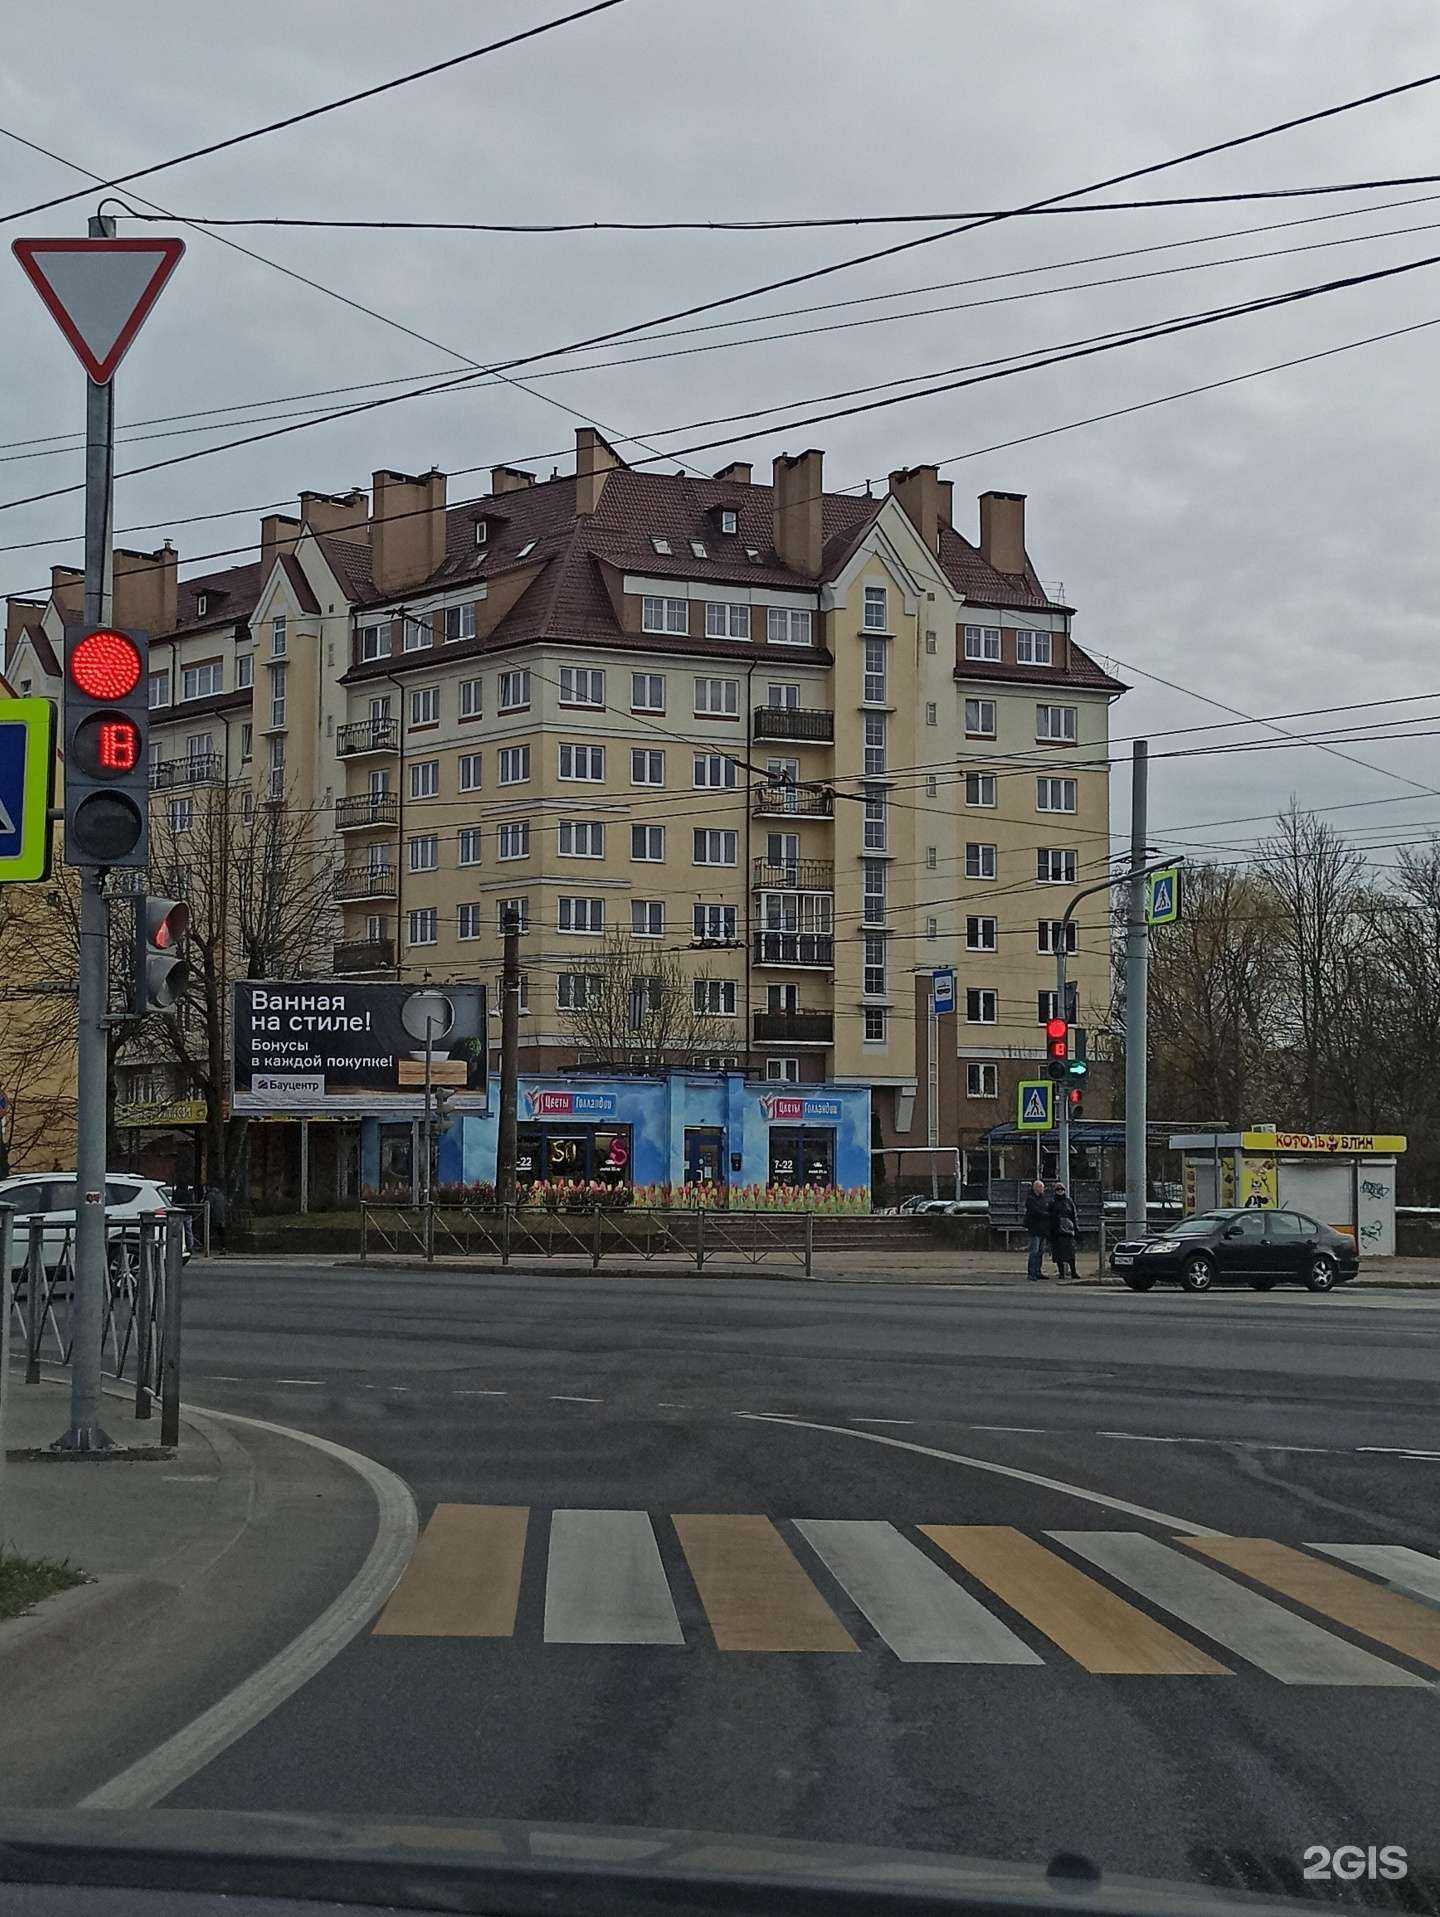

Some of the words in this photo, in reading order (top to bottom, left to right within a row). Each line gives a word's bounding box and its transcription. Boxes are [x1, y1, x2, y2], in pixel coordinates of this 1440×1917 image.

[103, 724, 134, 768] 18
[251, 990, 345, 1011] Ванная
[251, 1016, 281, 1031] на
[288, 1011, 371, 1032] стиле!
[251, 1039, 309, 1053] Бонусы
[251, 1059, 260, 1067] в
[264, 1054, 322, 1070] каждой
[326, 1055, 393, 1071] покупке!
[269, 1080, 319, 1092] Бауцентр
